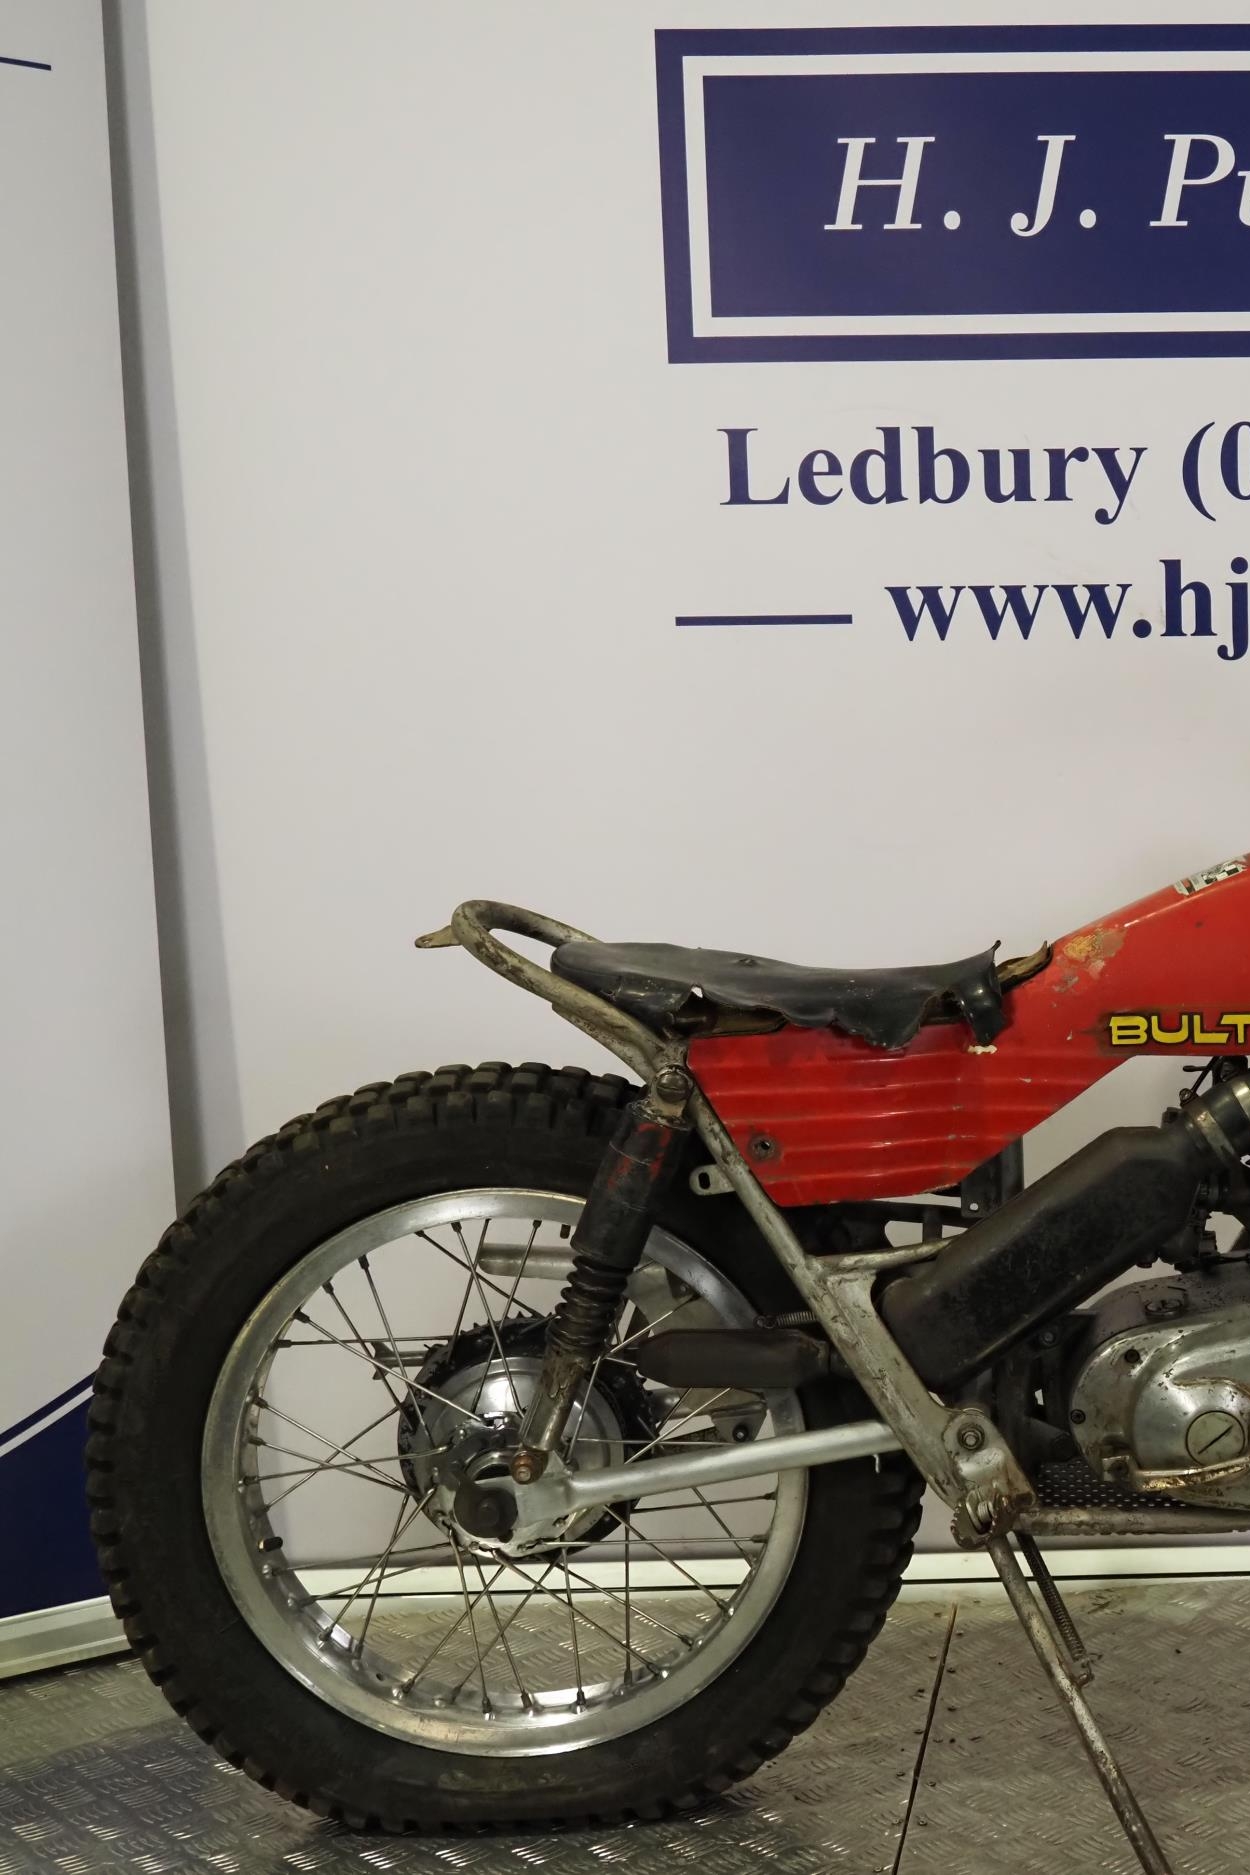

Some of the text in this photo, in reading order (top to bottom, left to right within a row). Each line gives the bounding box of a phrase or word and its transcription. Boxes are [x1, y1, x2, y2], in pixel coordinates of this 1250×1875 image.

[823, 136, 961, 231] H.
[1010, 134, 1097, 237] J.
[717, 425, 1149, 525] Ledbury
